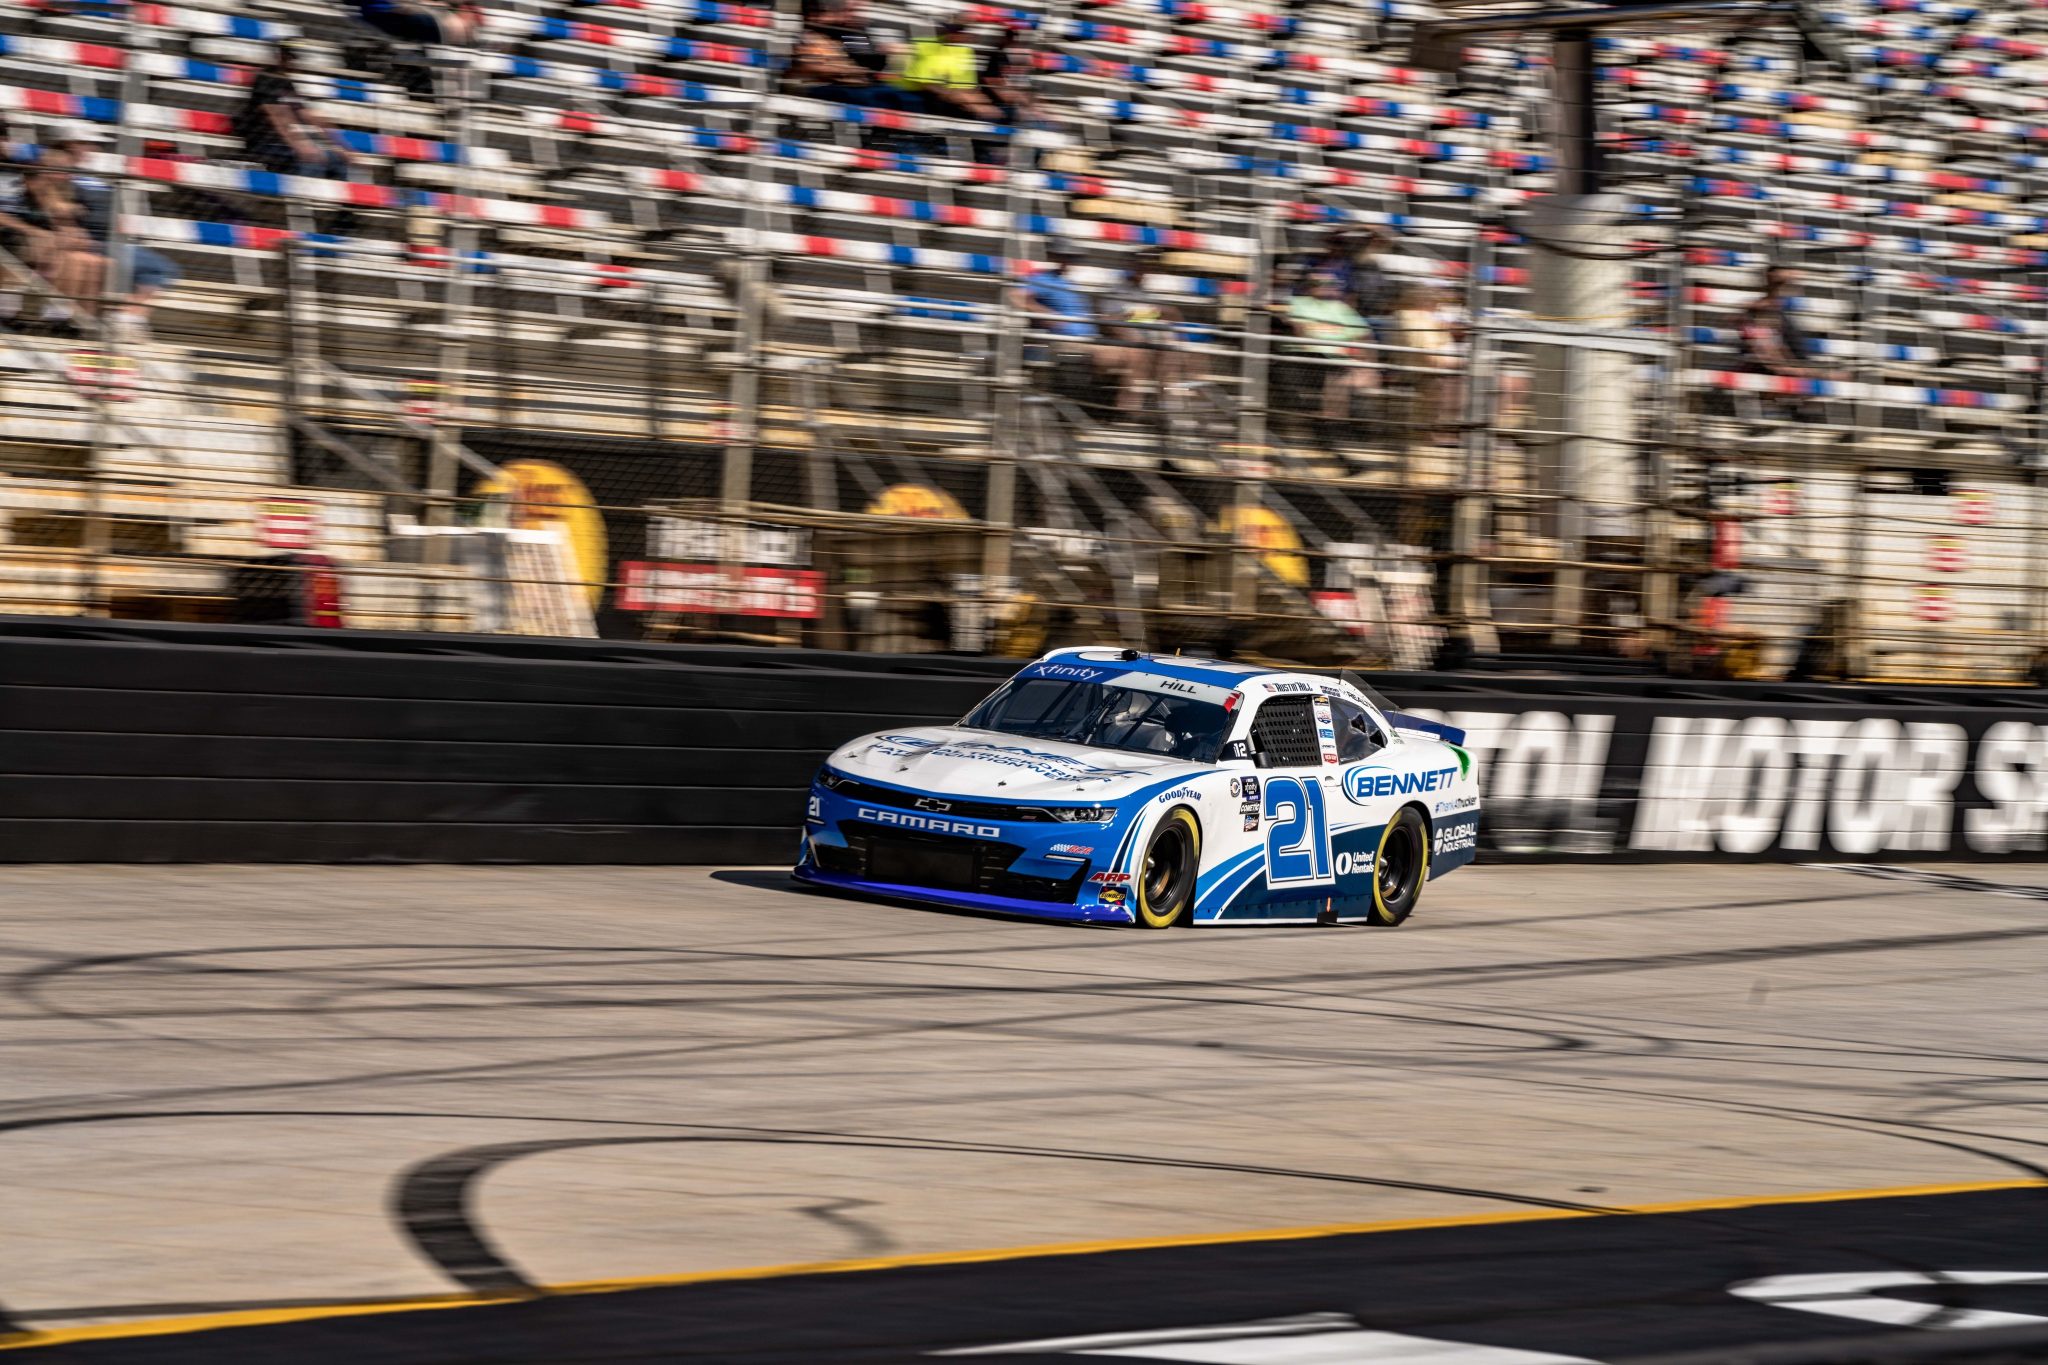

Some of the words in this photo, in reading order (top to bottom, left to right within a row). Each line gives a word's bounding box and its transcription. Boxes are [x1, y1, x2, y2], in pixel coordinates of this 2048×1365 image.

[1034, 664, 1103, 680] xfinity
[1160, 680, 1197, 694] HILL
[1356, 767, 1457, 798] BENNETT
[1628, 715, 1970, 855] MOTOR
[808, 796, 820, 817] 21
[858, 807, 1001, 838] CAMARO
[1264, 776, 1332, 883] 21
[1443, 822, 1476, 842] GLOBAL
[1442, 837, 1475, 853] INDUSTRIAL
[1352, 851, 1375, 863] United
[1352, 862, 1374, 874] Rentals
[1089, 872, 1131, 883] ARP
